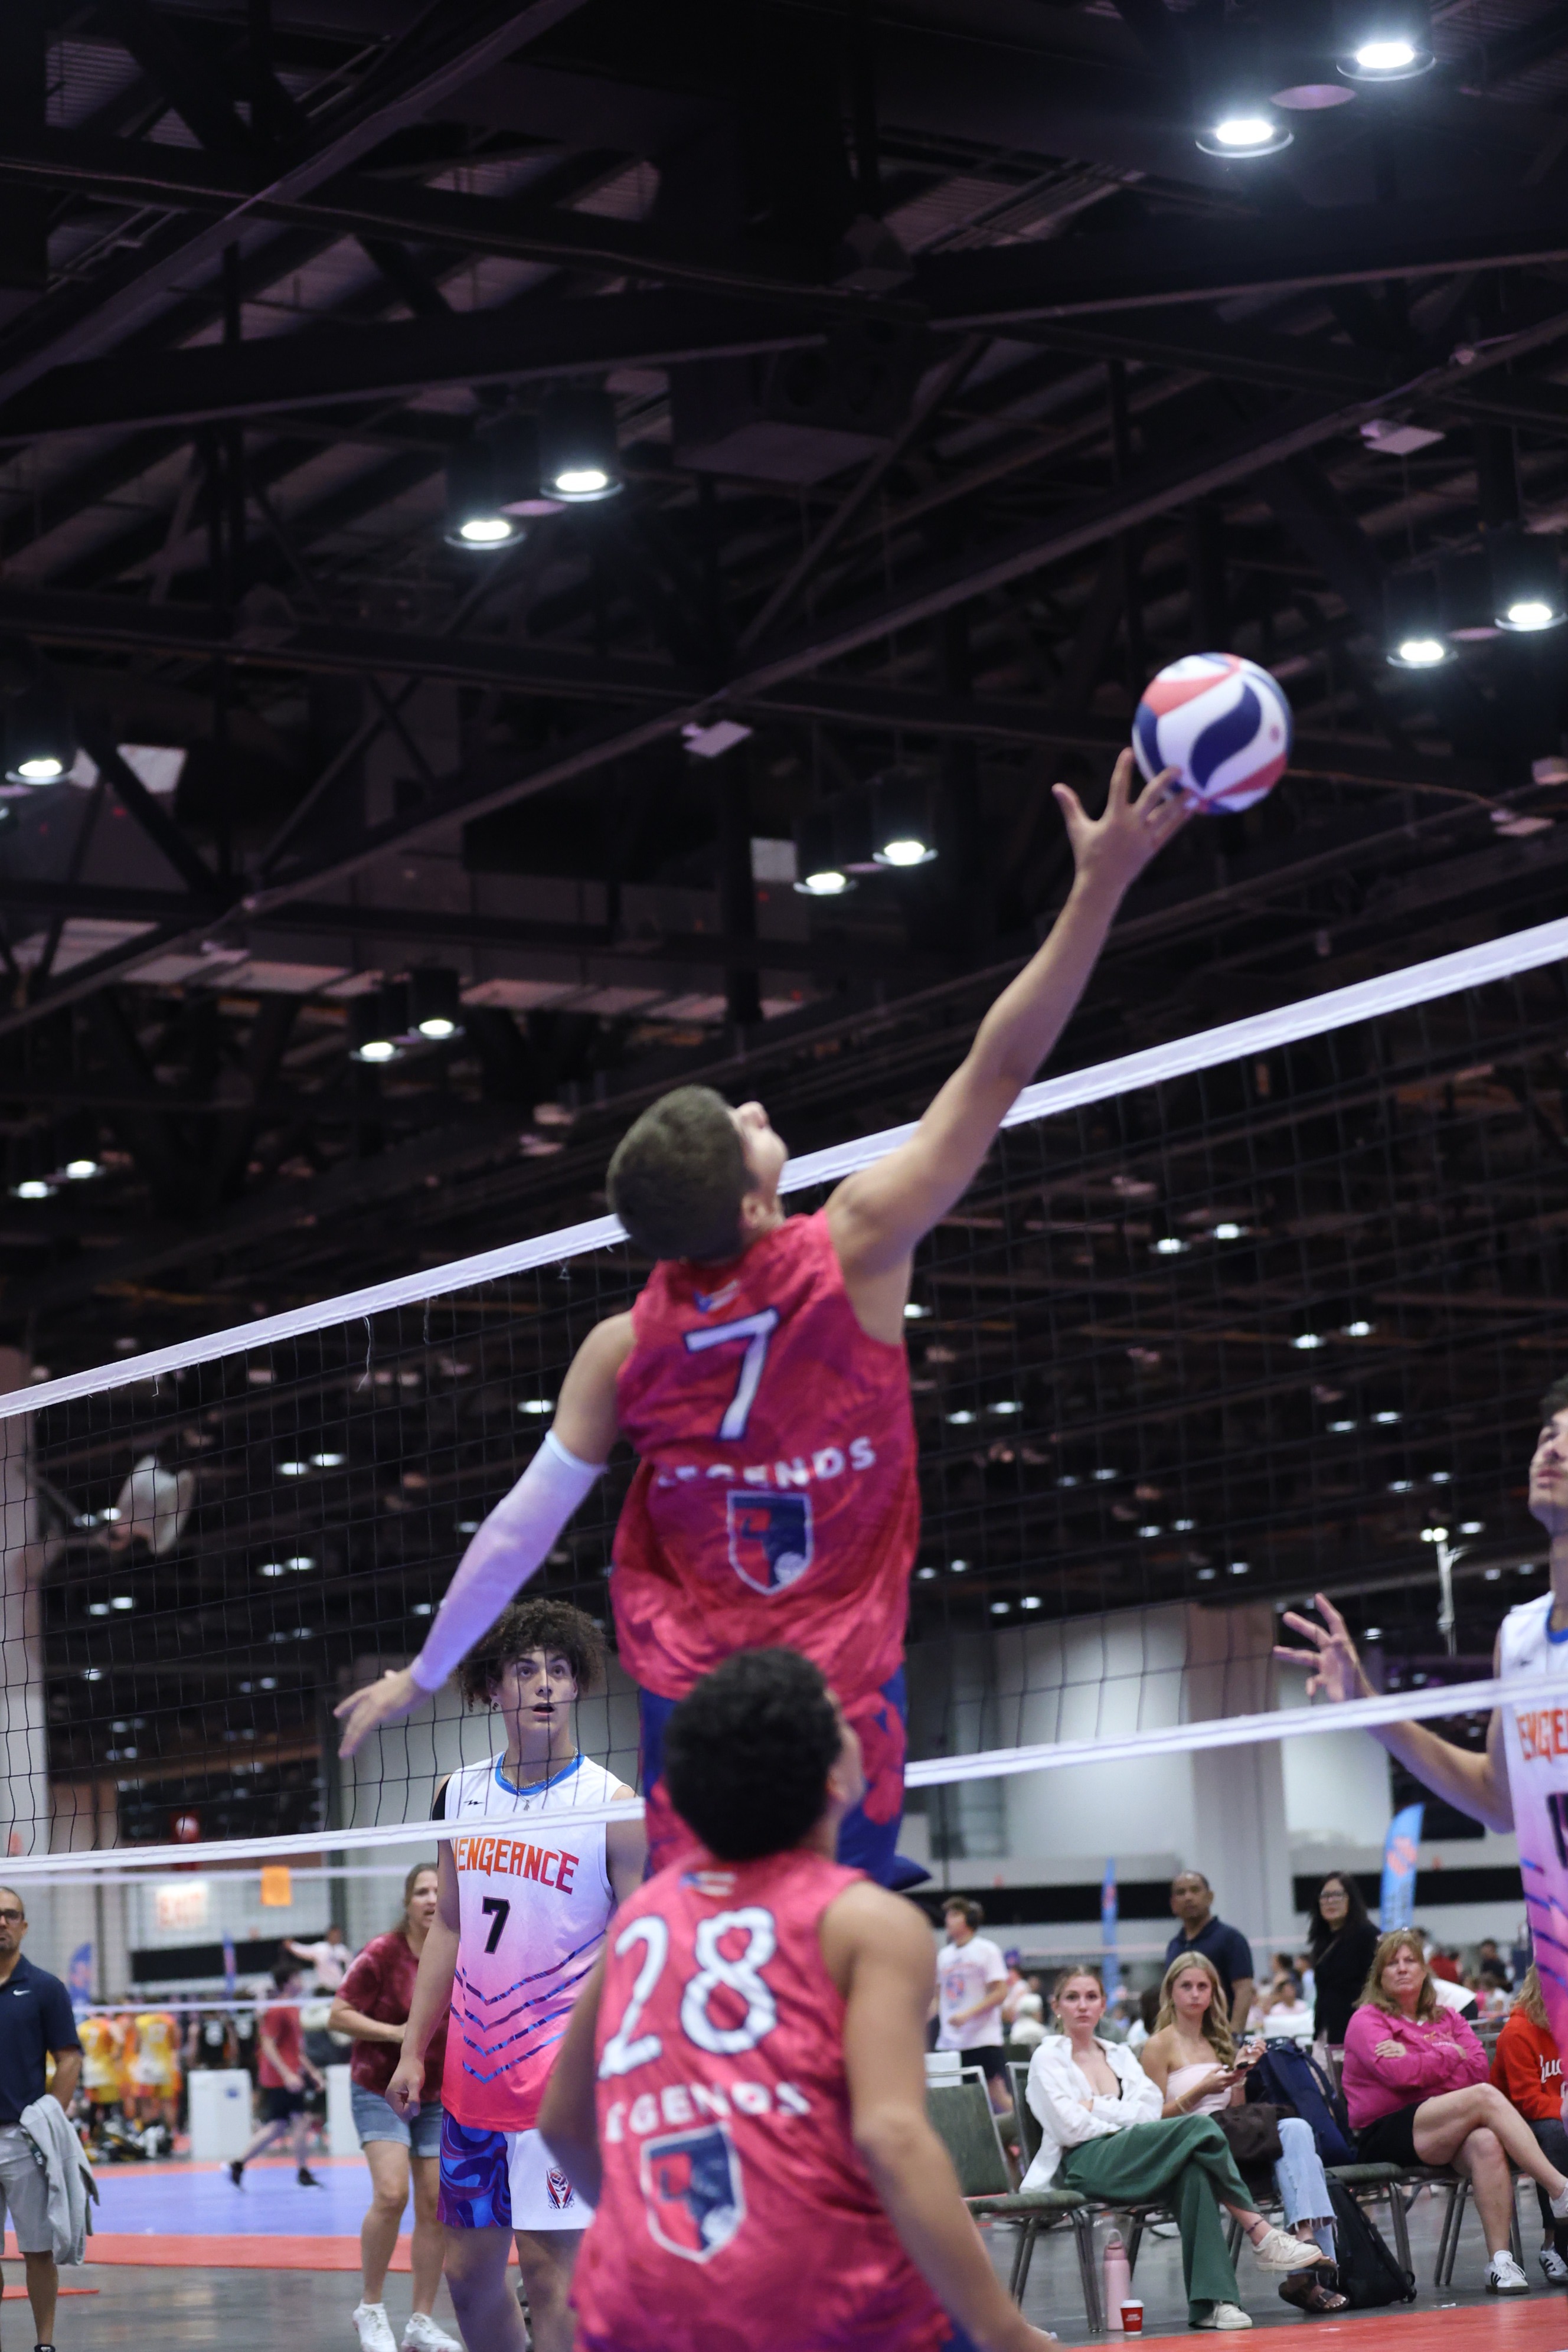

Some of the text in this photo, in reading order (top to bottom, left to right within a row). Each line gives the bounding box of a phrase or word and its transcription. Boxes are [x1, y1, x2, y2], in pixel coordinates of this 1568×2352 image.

[684, 1306, 778, 1440] 7
[482, 1896, 511, 1955] 7
[598, 1906, 776, 2079] 28
